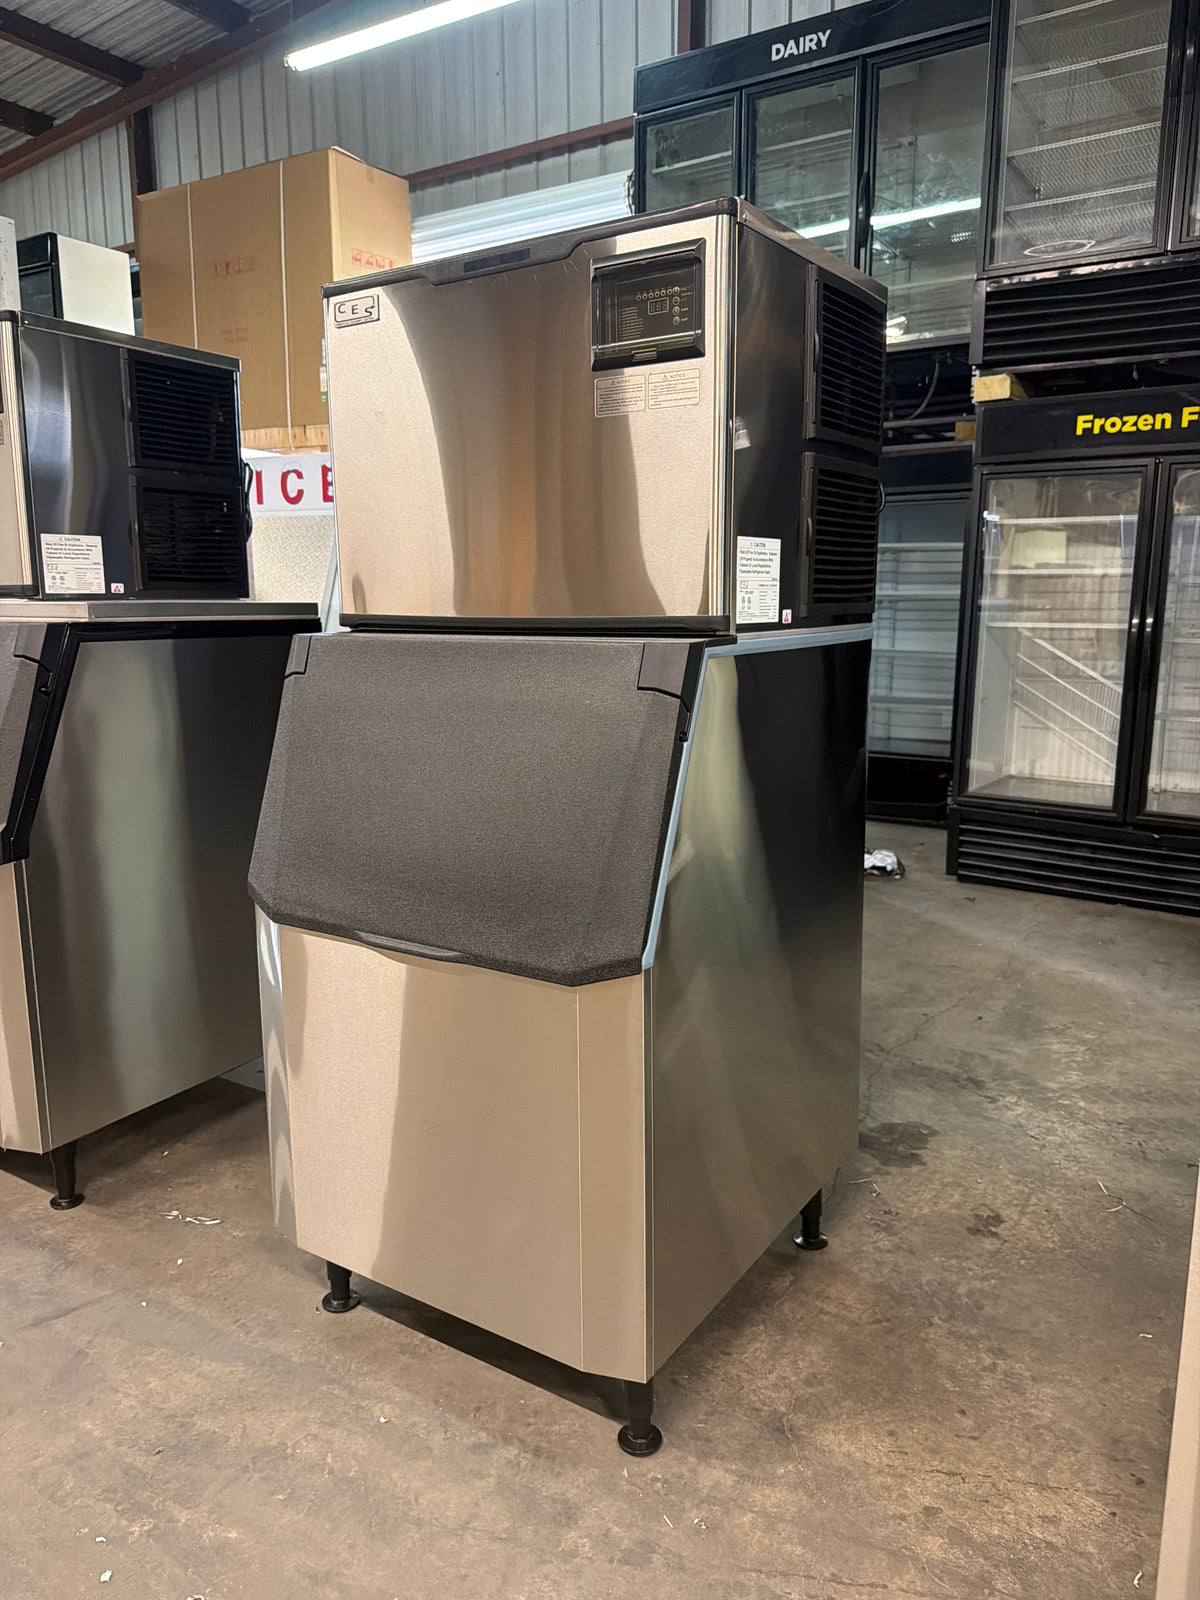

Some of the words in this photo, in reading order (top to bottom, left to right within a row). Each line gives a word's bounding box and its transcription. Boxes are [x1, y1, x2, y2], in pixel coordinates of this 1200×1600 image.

[771, 29, 832, 62] DAIRY
[338, 303, 375, 317] CES
[1075, 412, 1172, 436] Frozen
